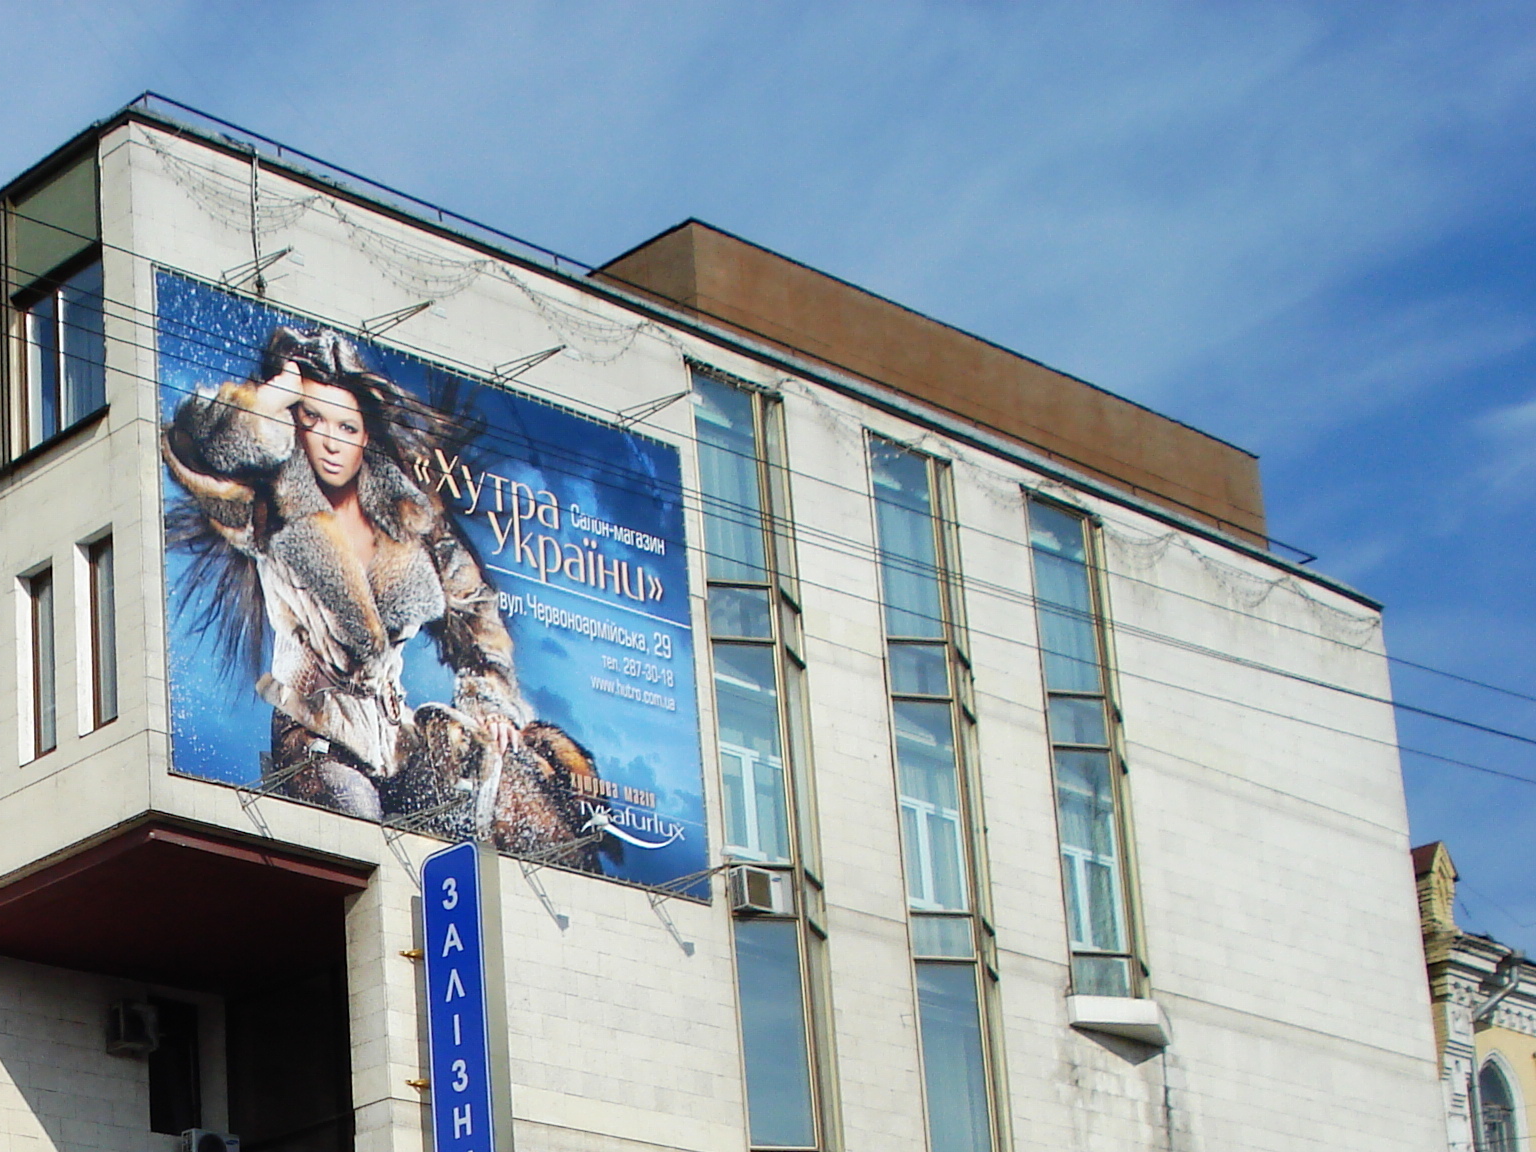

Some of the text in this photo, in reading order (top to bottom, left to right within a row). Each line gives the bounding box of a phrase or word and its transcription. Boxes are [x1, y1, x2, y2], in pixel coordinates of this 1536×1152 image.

[570, 503, 666, 556] Салон-магазин
[654, 632, 672, 659] 29
[602, 655, 675, 688] тел. 287-30-18
